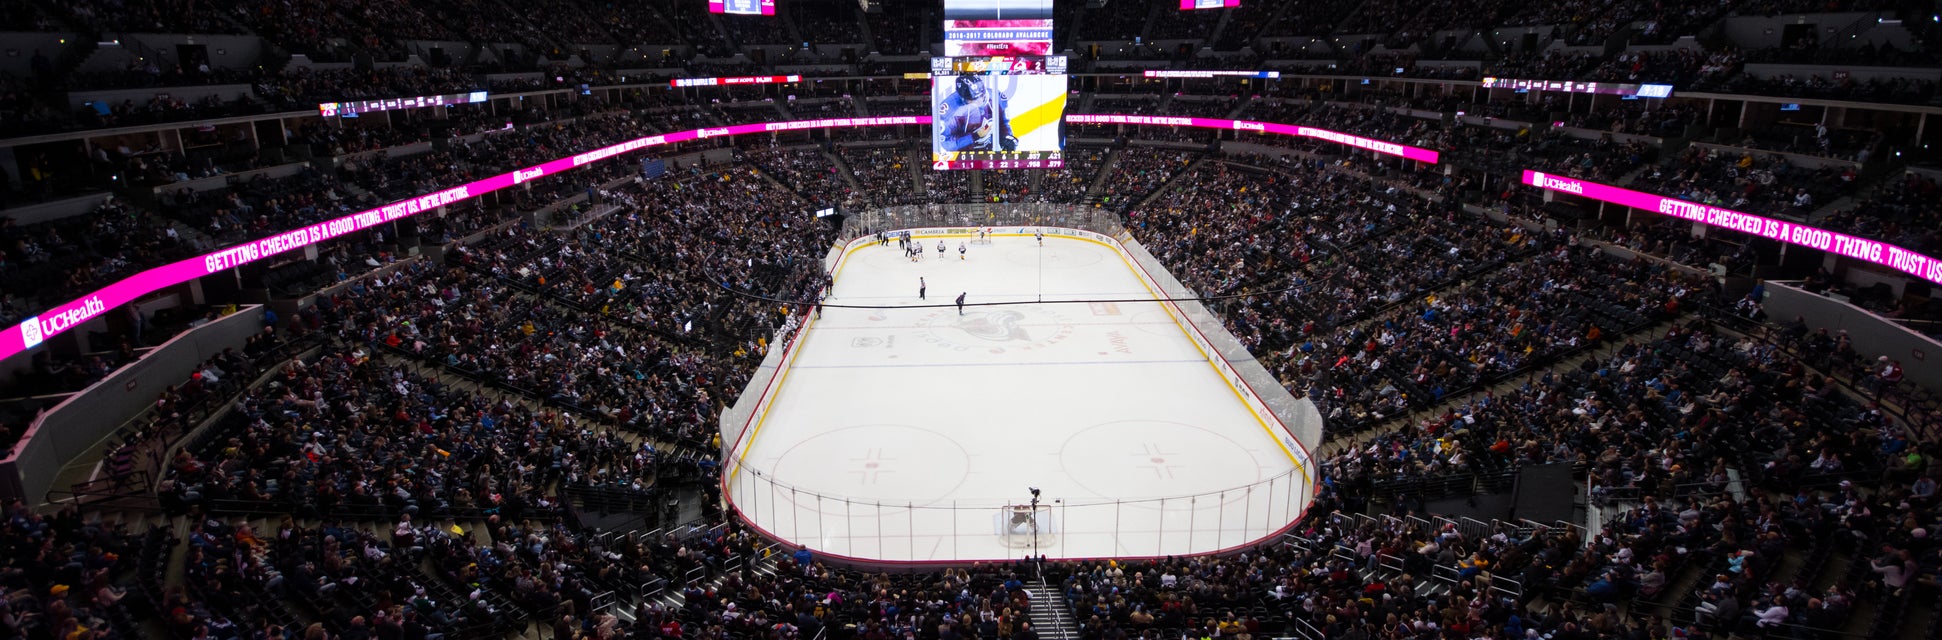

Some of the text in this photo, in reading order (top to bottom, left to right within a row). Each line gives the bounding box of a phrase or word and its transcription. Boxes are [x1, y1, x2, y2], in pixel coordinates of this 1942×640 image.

[1035, 62, 1040, 70] 2
[1543, 176, 1583, 194] UCHealth
[205, 186, 470, 273] GETTING CHECKED IS A GOOD THING. TRUST US. WE'RE DOCTORS.
[1659, 198, 1942, 282] GETTING CHECKED IS A GOOD THING. TRUST US
[42, 296, 105, 336] UCHealth
